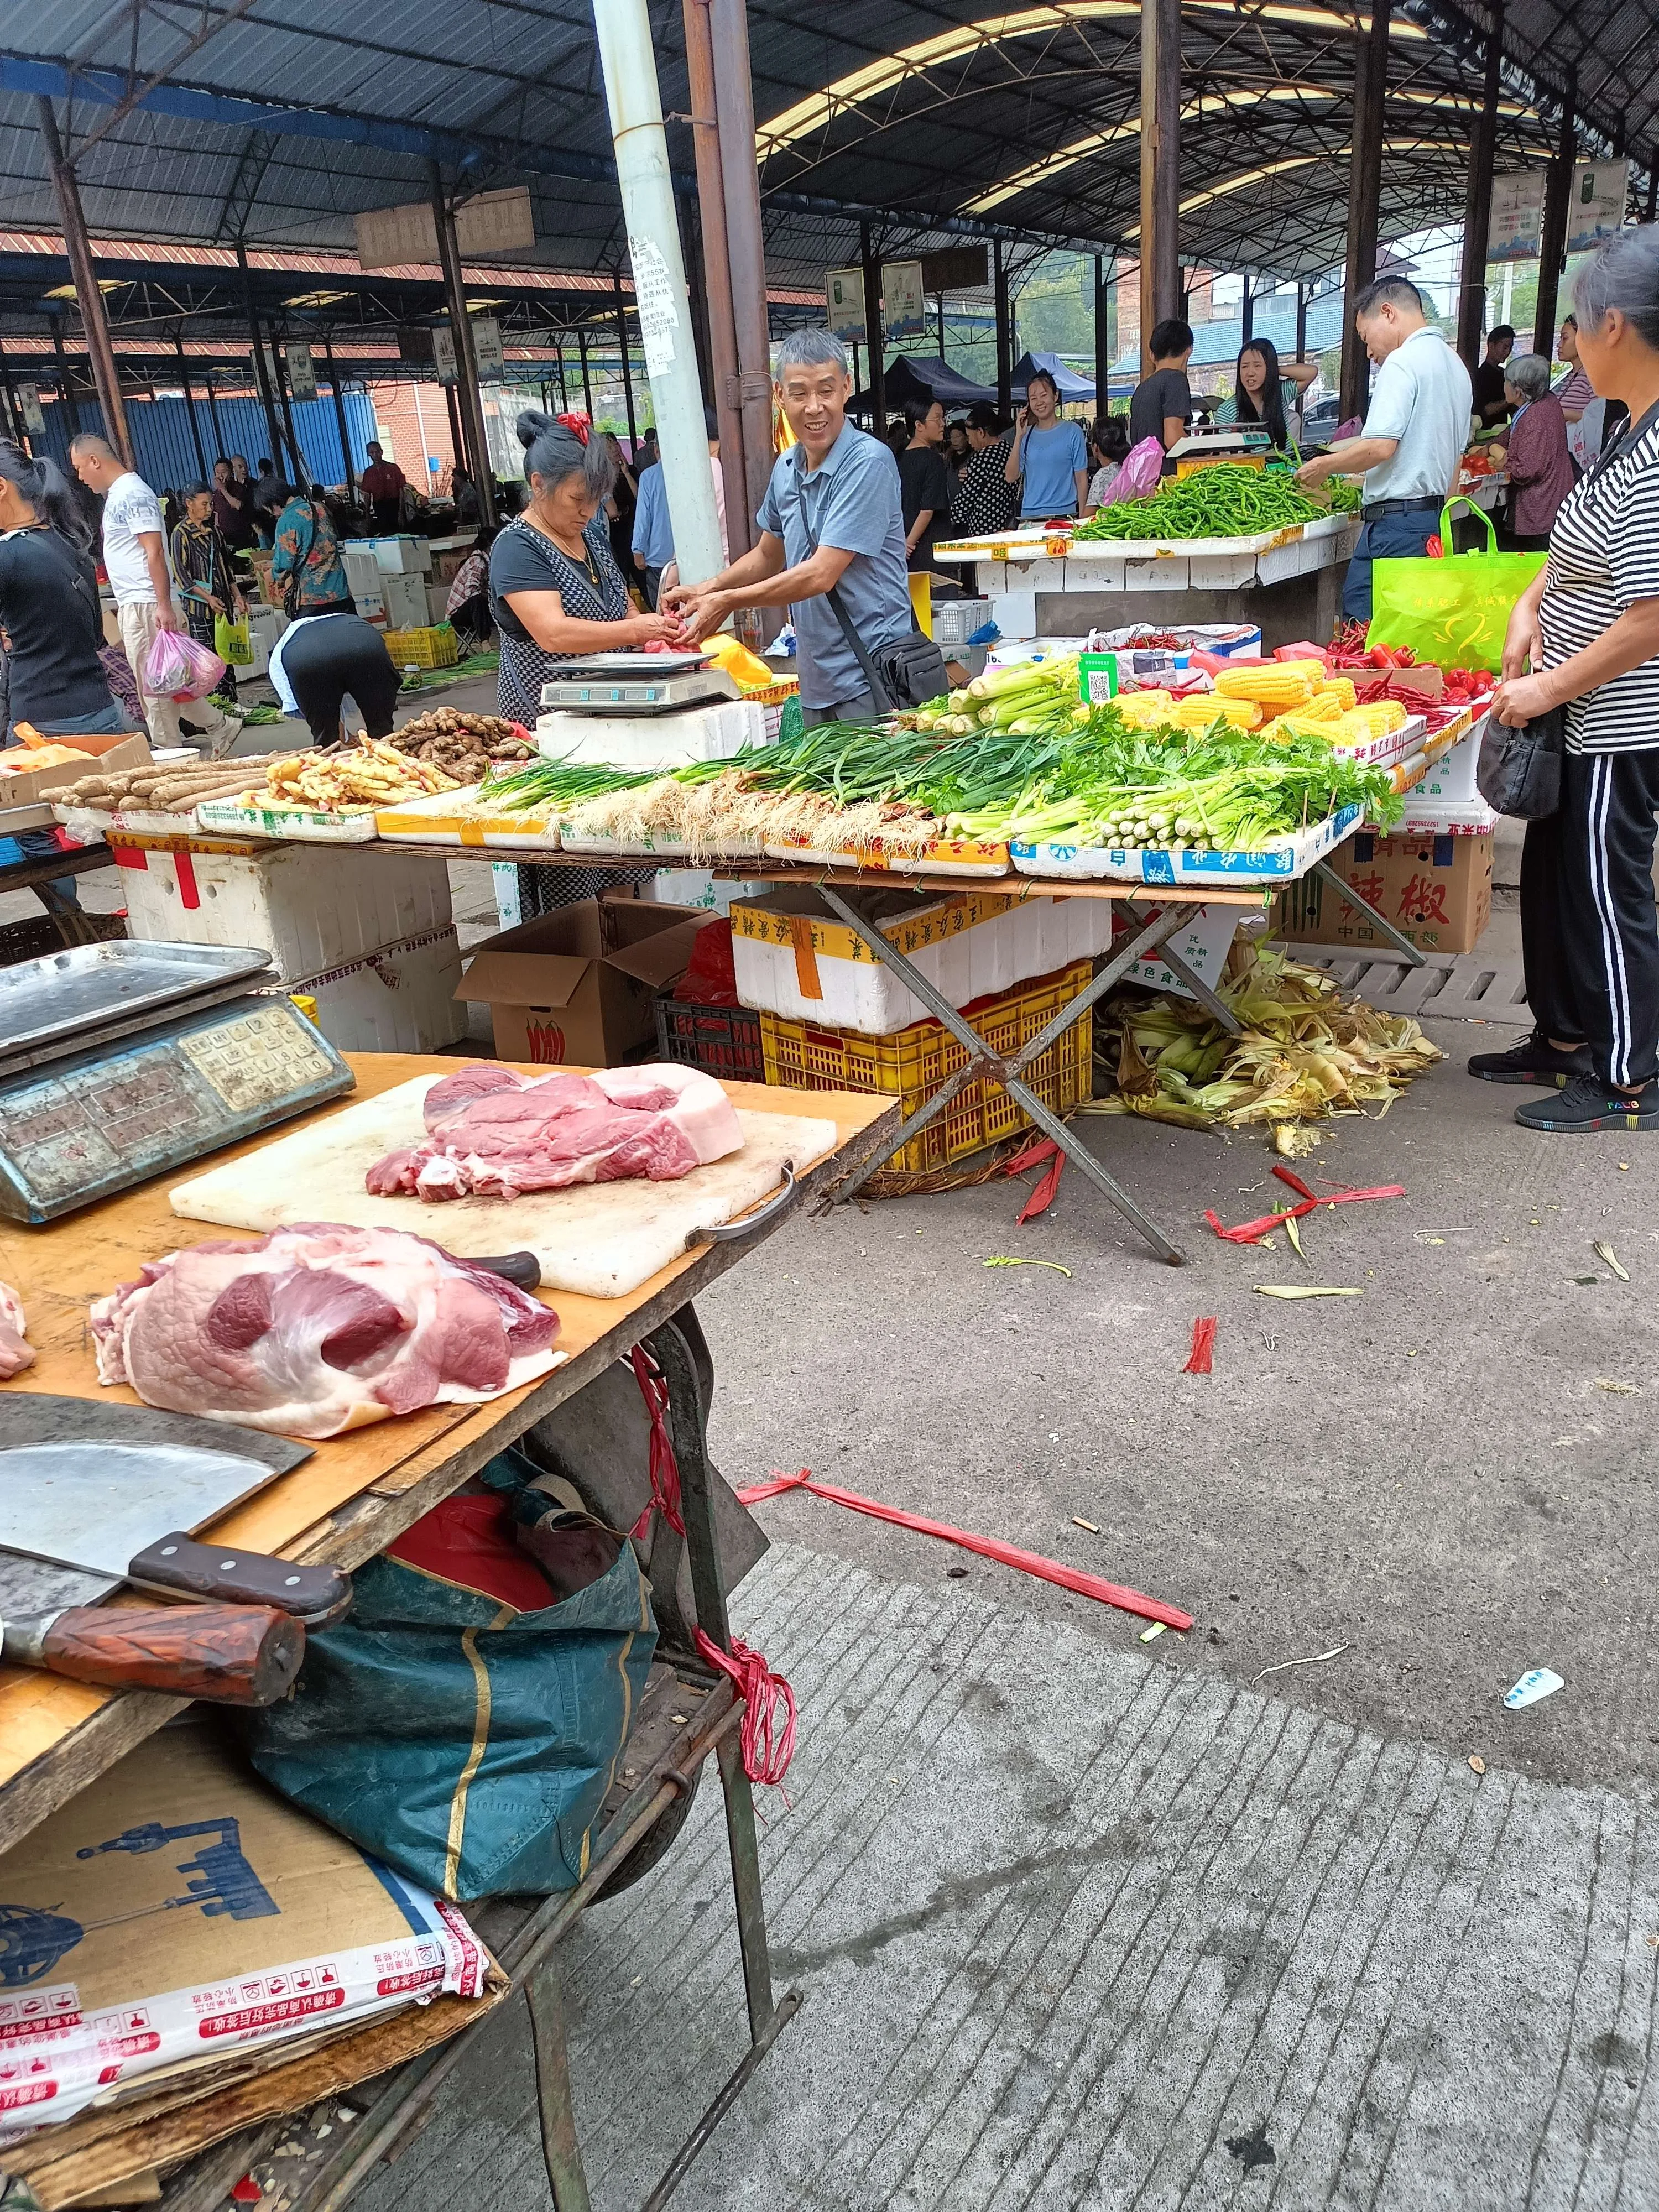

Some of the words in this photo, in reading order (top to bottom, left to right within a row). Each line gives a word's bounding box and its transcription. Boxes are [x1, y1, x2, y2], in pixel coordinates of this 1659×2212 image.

[1337, 925, 1374, 940] 中国
[373, 1949, 410, 1963] 小心轻放
[376, 1958, 413, 1974] 防潮防压
[191, 1987, 234, 2004] 小心轻放
[194, 1996, 238, 2014] 防潮防压
[208, 1991, 336, 2032] 请确认商品完好后签收!
[0, 2012, 82, 2039] 认商品完好
[0, 2084, 48, 2109] 请确认
